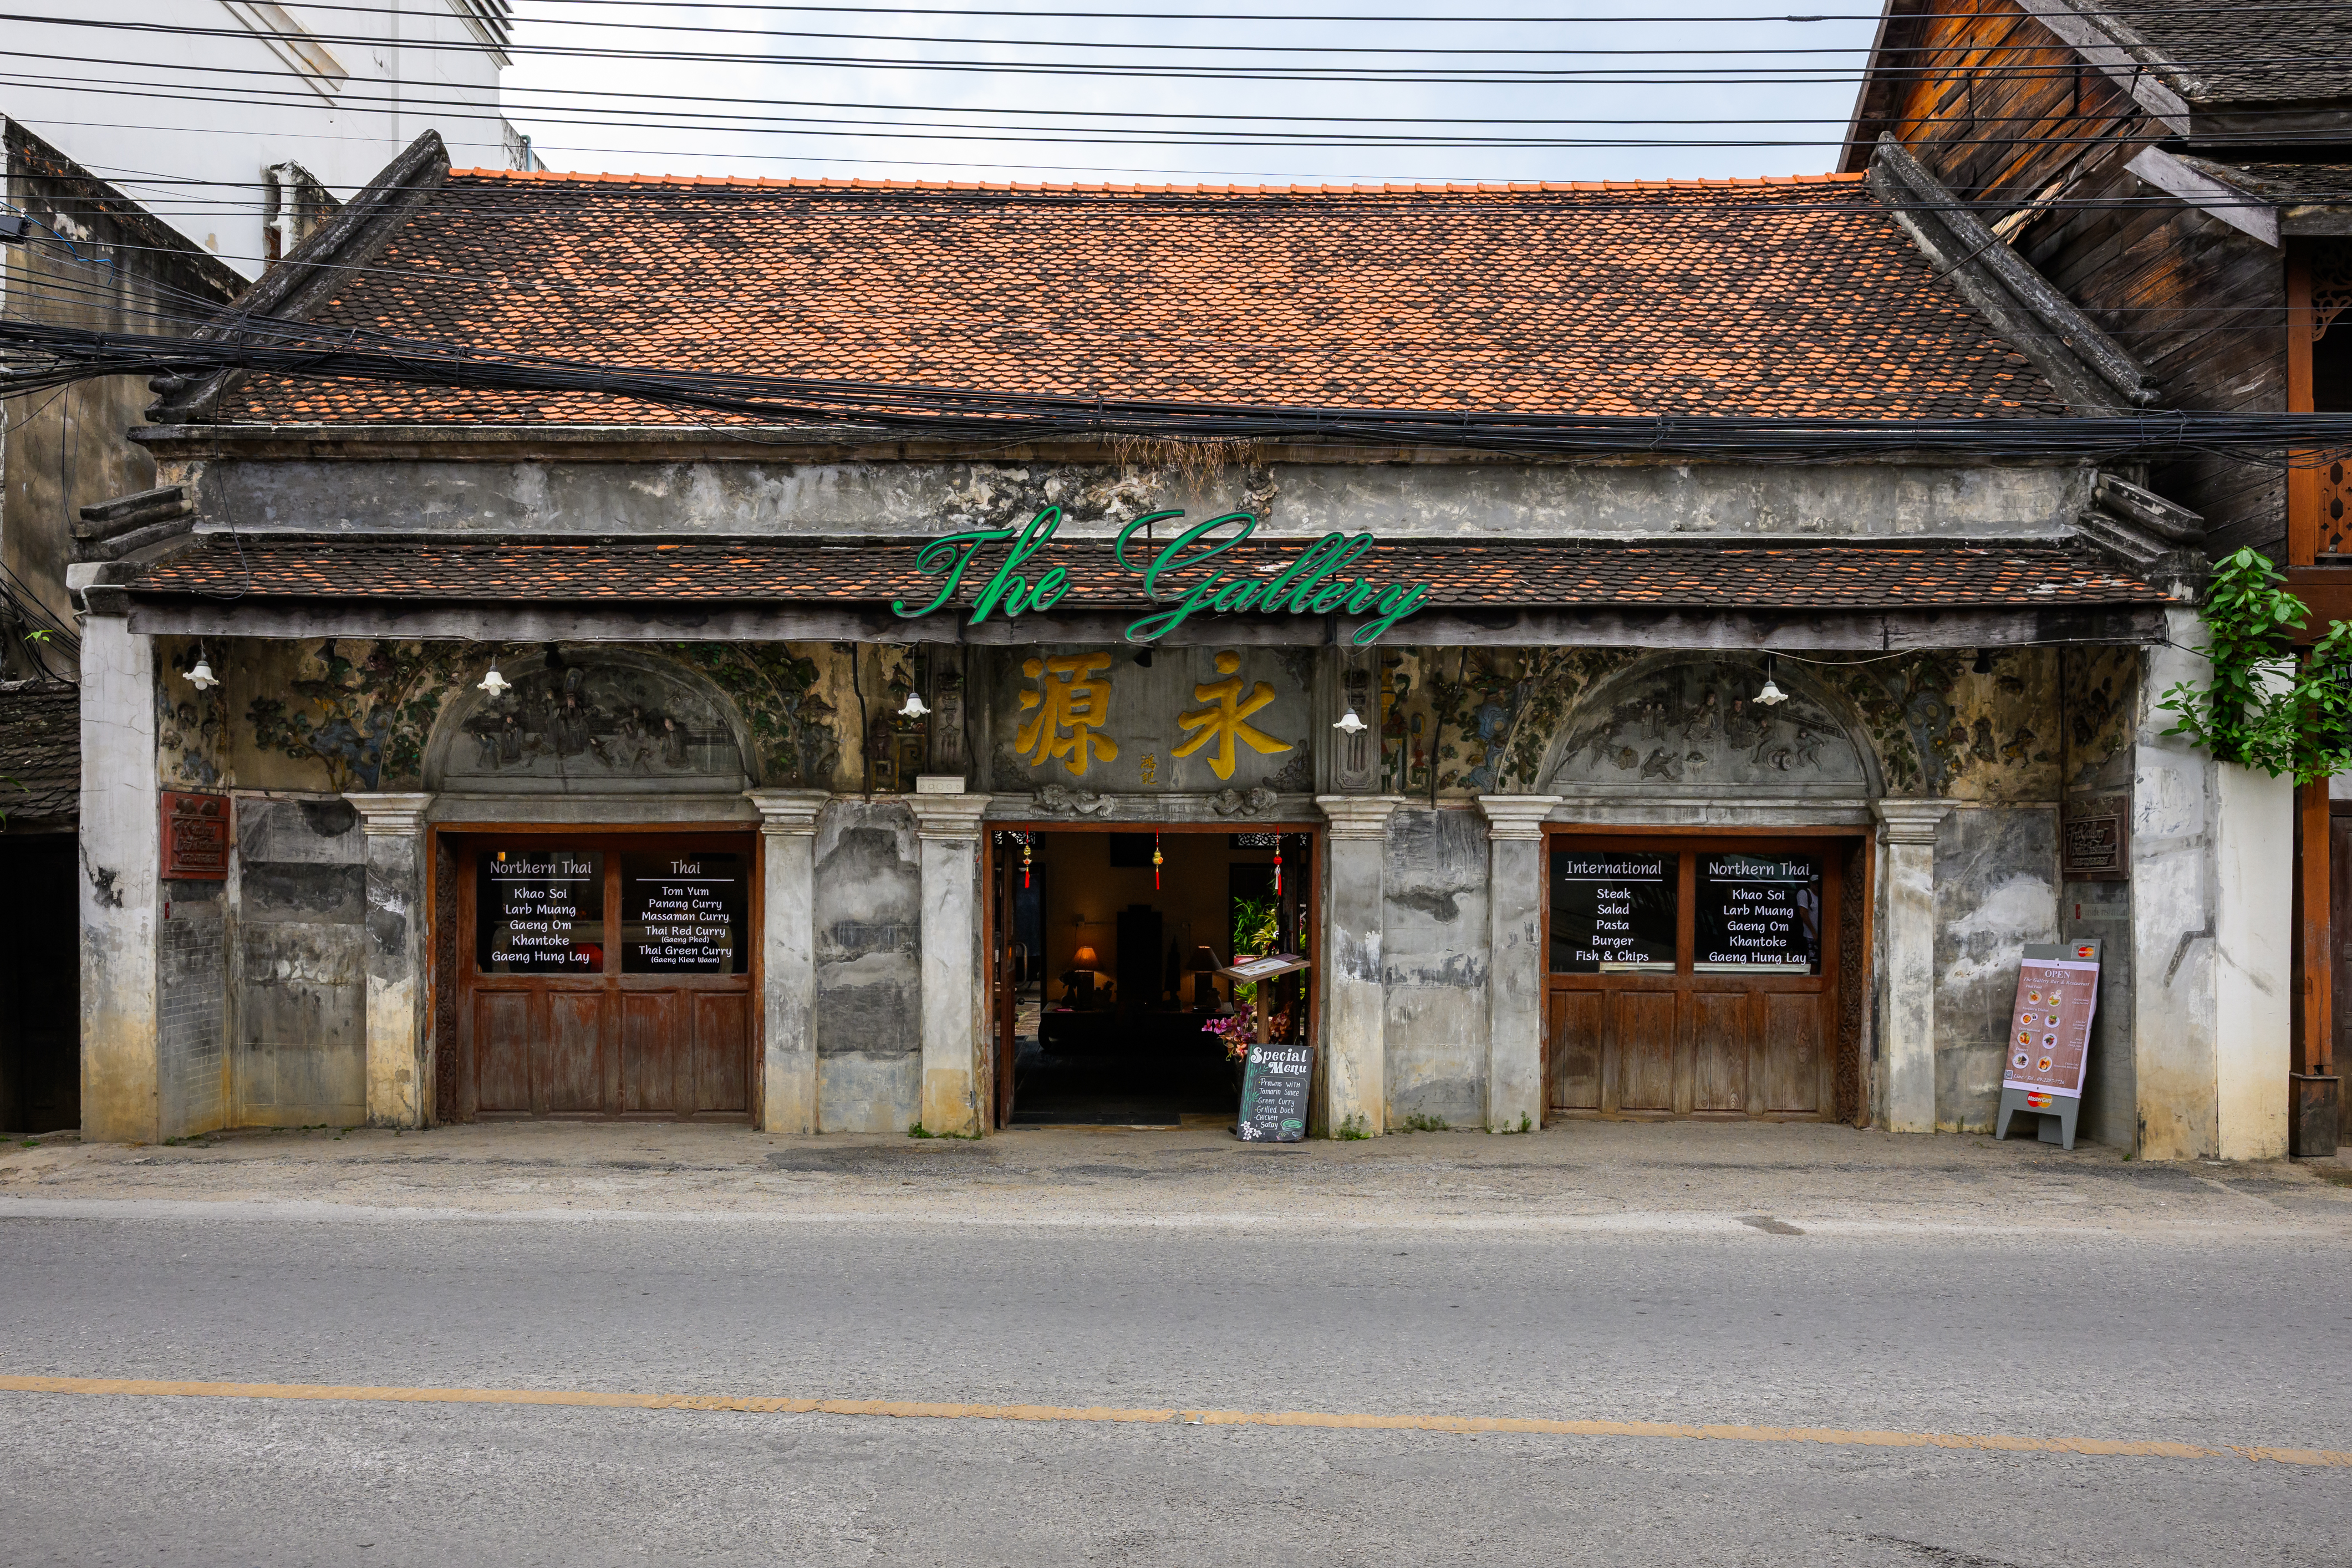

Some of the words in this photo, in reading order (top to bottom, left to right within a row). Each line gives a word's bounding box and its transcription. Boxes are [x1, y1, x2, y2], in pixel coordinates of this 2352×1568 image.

[891, 503, 1072, 626] The
[1114, 508, 1433, 645] Gallery
[491, 858, 555, 873] Northern
[562, 859, 591, 873] Thai
[671, 860, 700, 873] Thai
[1567, 861, 1661, 874] International
[1710, 861, 1774, 875] Northern
[1780, 861, 1809, 875] Thai
[515, 887, 544, 898] Khao
[549, 889, 567, 898] Soi
[1597, 888, 1630, 898] Steak
[1733, 889, 1762, 899] Khao
[1768, 890, 1785, 899] Soi
[506, 903, 532, 914] Larb
[537, 905, 576, 917] Muang
[649, 899, 688, 910] Panang
[693, 899, 721, 910] Curry
[1597, 903, 1628, 914] Salad
[1724, 904, 1749, 914] Larb
[1755, 906, 1793, 918] Muang
[700, 912, 729, 923] Curry
[510, 920, 547, 932] Gaeng
[553, 920, 571, 929] Om
[1597, 920, 1628, 929] Pasta
[1728, 921, 1765, 933] Gaeng
[1770, 922, 1788, 931] Om
[645, 925, 668, 935] Thai
[673, 925, 691, 935] Red
[694, 927, 725, 939] Curry
[513, 934, 569, 945] Khantoke
[1593, 935, 1633, 948] Burger
[1730, 935, 1786, 946] Khantoke
[492, 951, 529, 963] Gaeng
[535, 951, 564, 964] Hung
[570, 951, 589, 964] Lay
[639, 945, 661, 954] Thai
[665, 946, 697, 955] Green
[702, 946, 731, 959] Curry
[1576, 950, 1599, 960] Fish
[1604, 951, 1612, 960] &
[1617, 951, 1649, 964] Chips
[1709, 952, 1747, 964] Gaeng
[1752, 952, 1782, 965] Hung
[1786, 953, 1806, 965] Lay
[2045, 970, 2071, 979] OPEN
[1251, 1047, 1307, 1063] Special
[1268, 1062, 1307, 1075] Menu
[1260, 1078, 1282, 1087] Prawns
[1279, 1098, 1295, 1107] Curry
